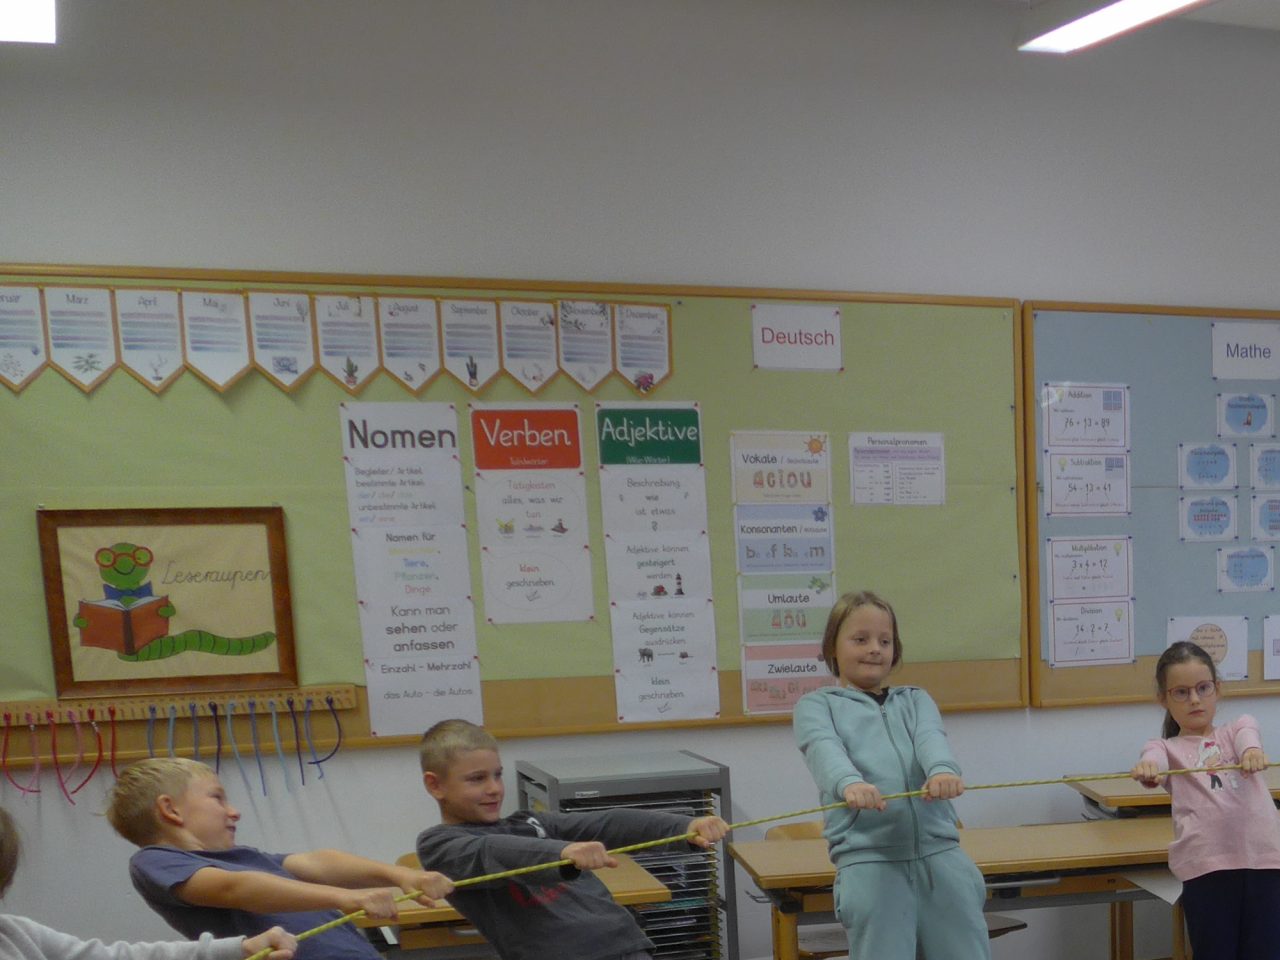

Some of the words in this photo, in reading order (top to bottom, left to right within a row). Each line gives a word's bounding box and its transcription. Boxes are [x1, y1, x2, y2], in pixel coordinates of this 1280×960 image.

[65, 293, 88, 305] März
[138, 296, 157, 309] April
[273, 299, 290, 308] Juni
[336, 301, 350, 311] Juli
[392, 303, 419, 315] August
[450, 304, 487, 316] September
[511, 306, 539, 316] Oktober
[761, 327, 834, 346] Deutsch
[1226, 343, 1271, 359] Mathe
[348, 419, 456, 448] Nomen
[480, 419, 572, 446] Verben
[601, 417, 698, 447] Adjektive
[741, 453, 778, 464] Vokale
[627, 478, 681, 488] Beschreibung
[740, 525, 797, 535] Konsonanten
[386, 533, 418, 542] Nomen
[422, 532, 436, 541] für
[626, 545, 659, 554] Adjektive
[519, 564, 540, 572] klein
[637, 559, 675, 569] gesteigert
[161, 560, 270, 590] Leseraupen
[768, 594, 810, 604] Umlaute
[391, 606, 421, 616] Kann
[425, 606, 450, 615] man
[632, 612, 664, 621] Adjektive
[385, 622, 427, 635] sehen
[431, 622, 458, 633] oder
[639, 624, 685, 635] Gegensätze
[393, 639, 455, 652] anfassen
[381, 663, 416, 674] Einzahl
[427, 661, 471, 672] Mehrzahl
[768, 664, 817, 674] Zwielaute
[650, 677, 670, 686] klein
[384, 690, 401, 700] das
[403, 690, 423, 699] Auto
[433, 689, 447, 698] die
[448, 687, 473, 696] Autos
